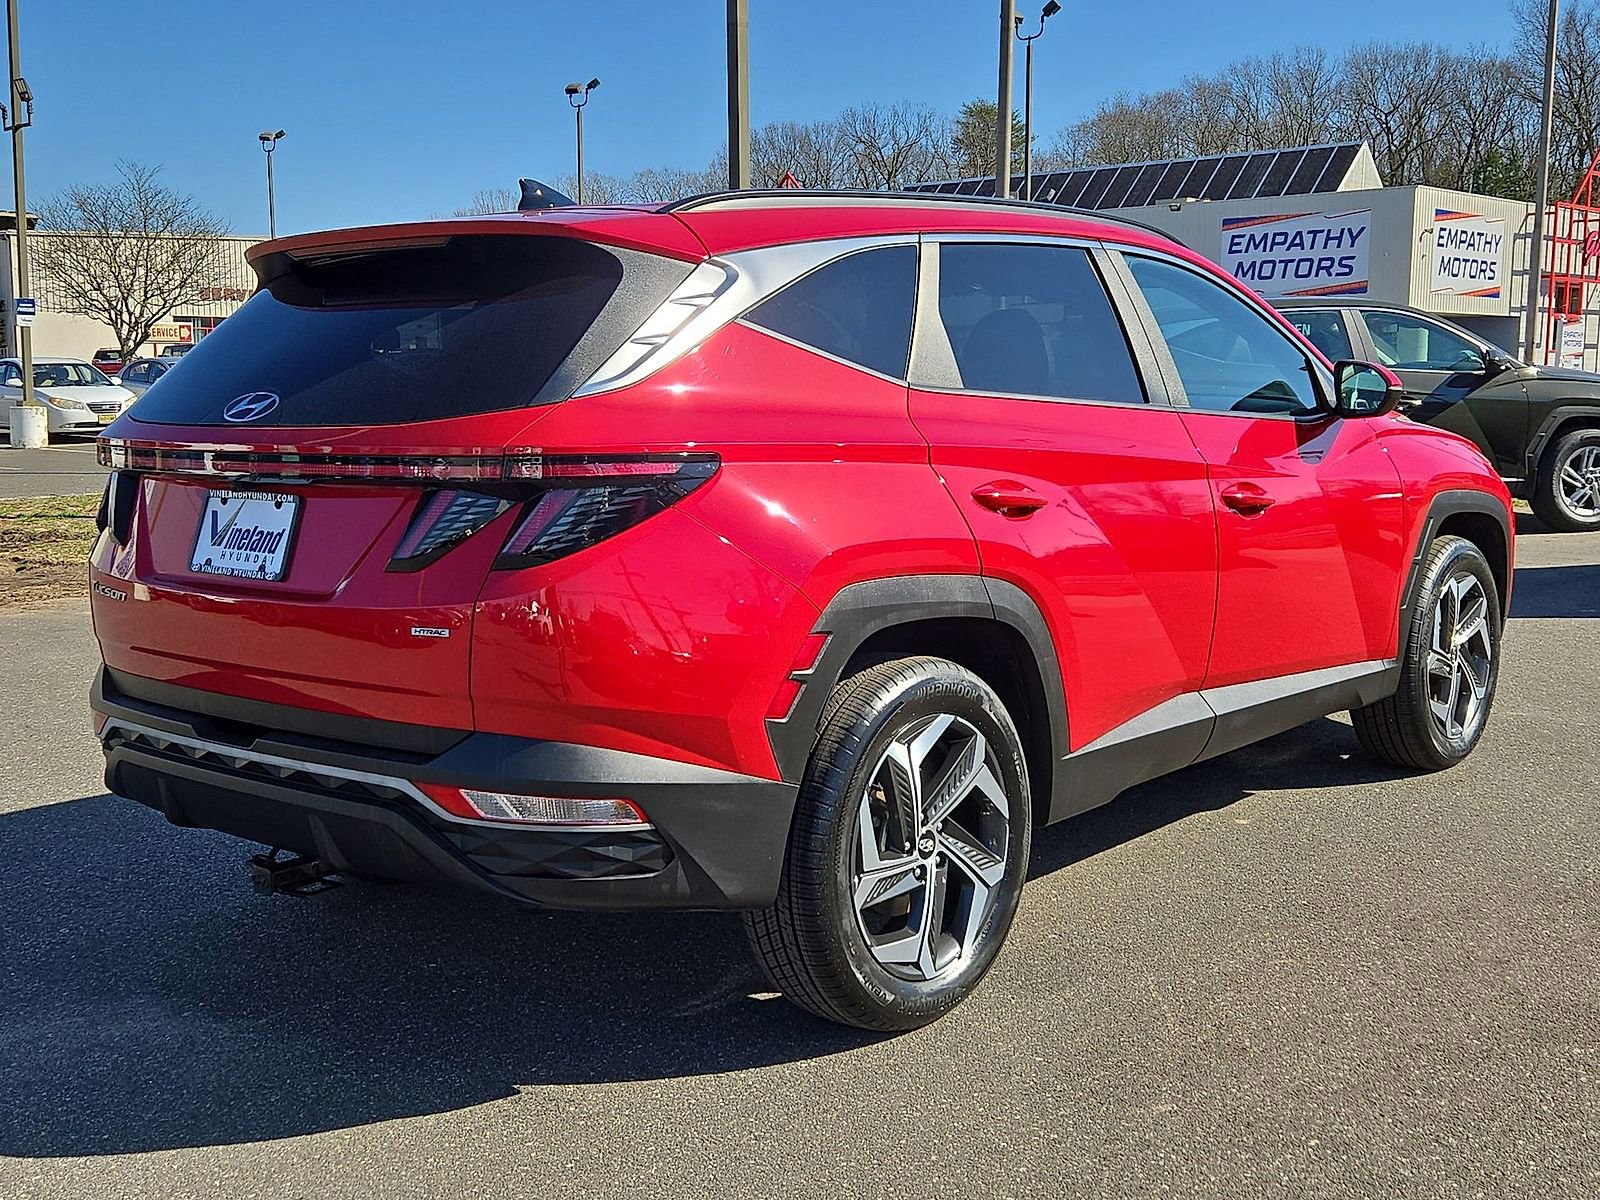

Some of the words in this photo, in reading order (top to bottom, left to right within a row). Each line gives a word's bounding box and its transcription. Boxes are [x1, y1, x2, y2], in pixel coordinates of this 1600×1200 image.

[1227, 226, 1367, 255] EMPATHY
[1436, 226, 1502, 254] EMPATHY
[1233, 255, 1357, 281] MOTORS
[1438, 256, 1497, 281] MOTORS
[209, 489, 294, 503] VINELANDHYUNDAI.COM
[211, 499, 286, 555] Vineland
[220, 550, 275, 566] HYUNDAI
[201, 564, 232, 576] VINELAND
[233, 567, 265, 579] HYUNDAI
[413, 628, 448, 636] HTRAC
